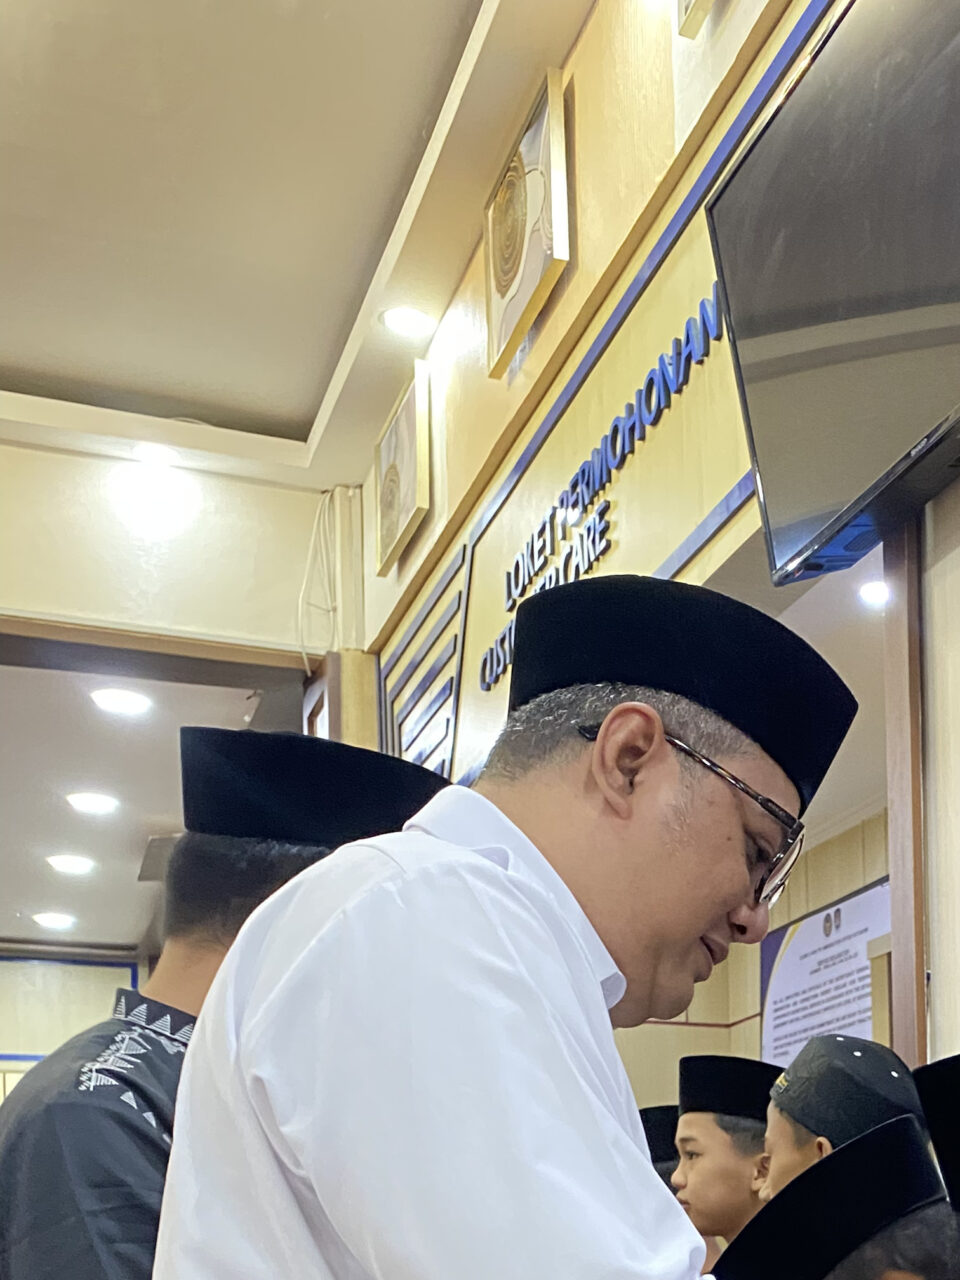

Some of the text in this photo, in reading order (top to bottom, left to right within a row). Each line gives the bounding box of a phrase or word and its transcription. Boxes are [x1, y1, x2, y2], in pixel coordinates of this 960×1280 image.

[506, 281, 722, 612] LOKET PERMOHONAN
[559, 500, 611, 587] CARE
